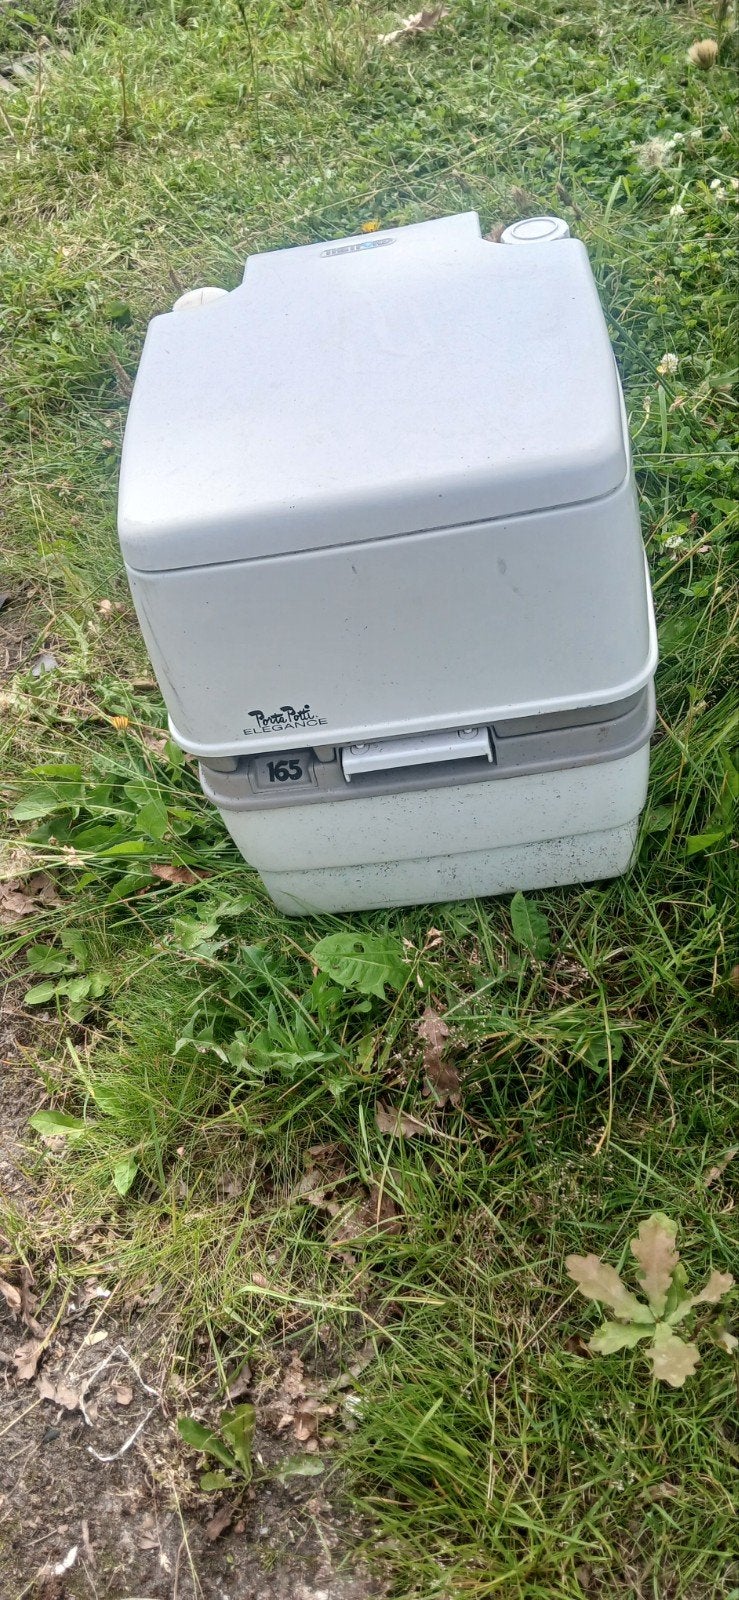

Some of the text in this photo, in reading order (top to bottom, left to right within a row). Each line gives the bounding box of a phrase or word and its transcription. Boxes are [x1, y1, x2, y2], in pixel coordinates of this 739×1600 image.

[243, 718, 328, 735] ELEGANCE
[248, 710, 287, 728] Porta
[266, 759, 303, 782] 165
